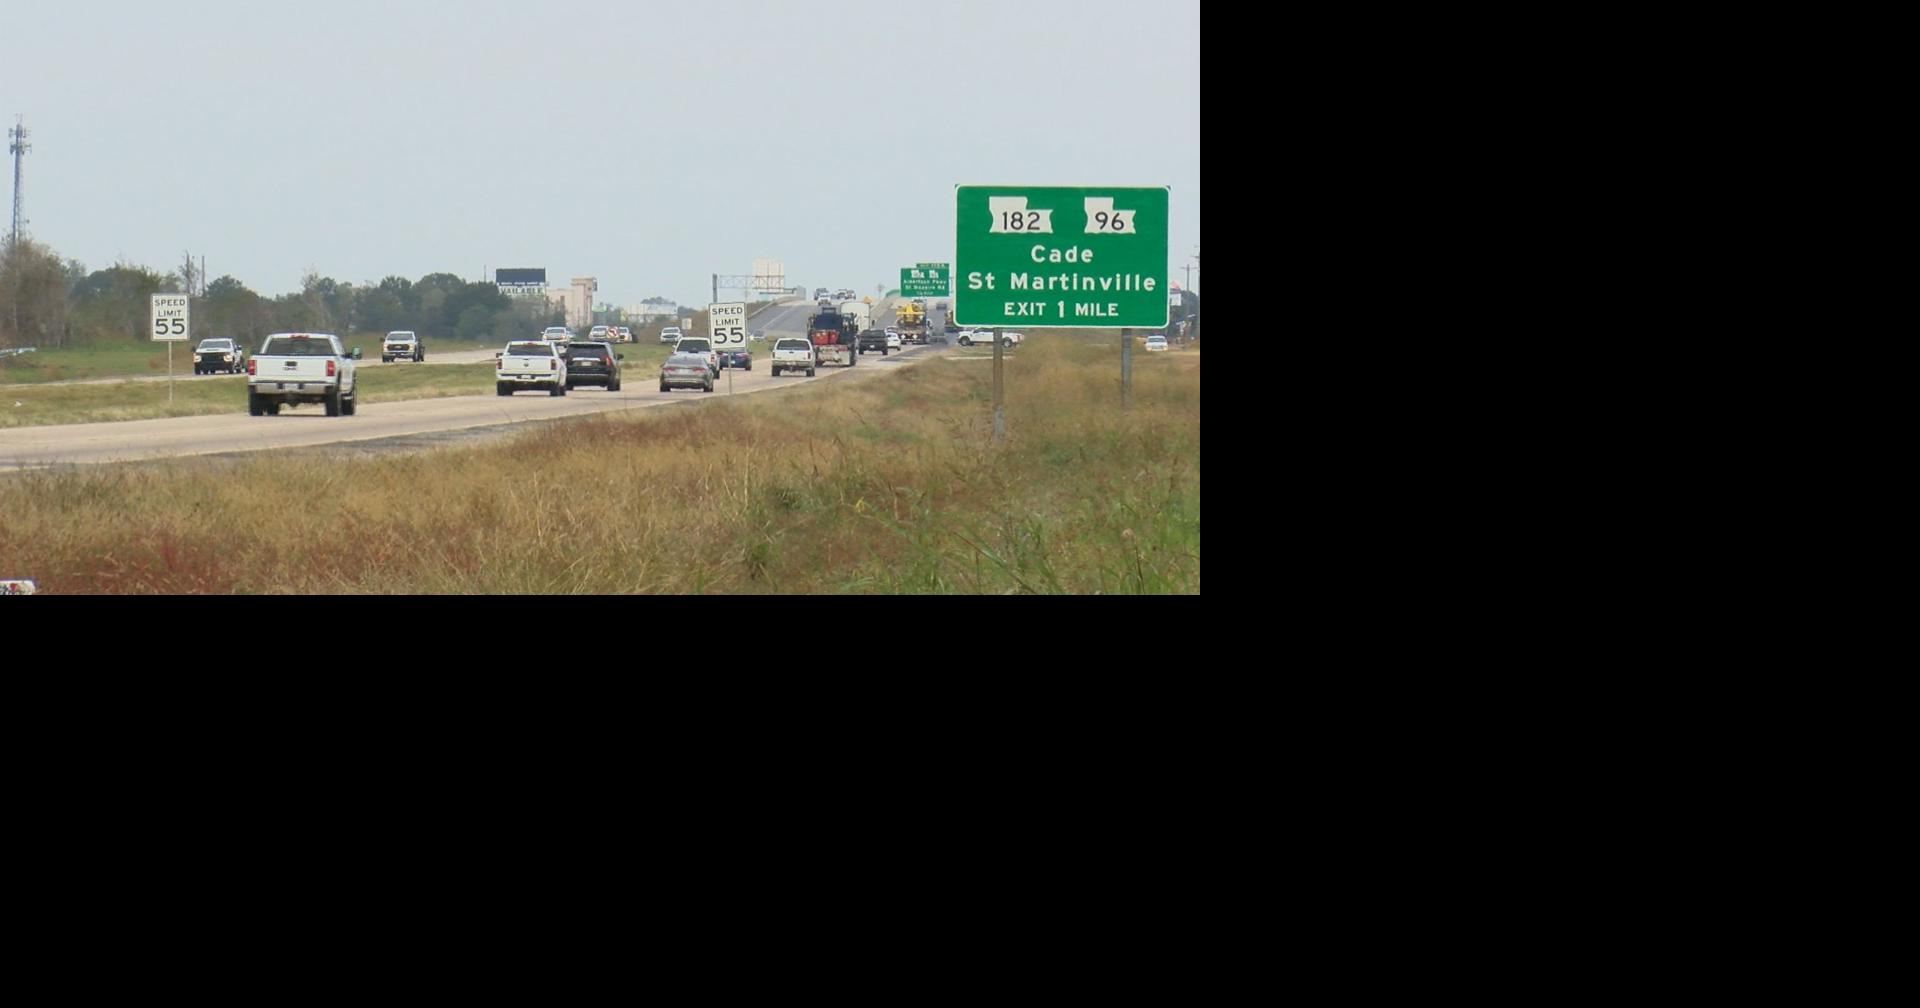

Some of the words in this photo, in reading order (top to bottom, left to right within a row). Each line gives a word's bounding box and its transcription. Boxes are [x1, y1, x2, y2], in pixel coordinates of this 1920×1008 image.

[1002, 211, 1041, 231] 182
[1094, 211, 1126, 231] 96
[1030, 244, 1094, 264] Cade
[968, 271, 996, 290] St
[1010, 272, 1157, 292] Martinville
[154, 298, 186, 306] SPEED
[711, 306, 743, 315] SPEED
[1004, 302, 1046, 317] EXIT
[1057, 300, 1066, 318] 1
[1075, 302, 1119, 317] MILE
[157, 309, 182, 317] LIMIT
[155, 318, 185, 335] 55
[715, 318, 740, 326] LIMIT
[714, 327, 744, 344] 55
